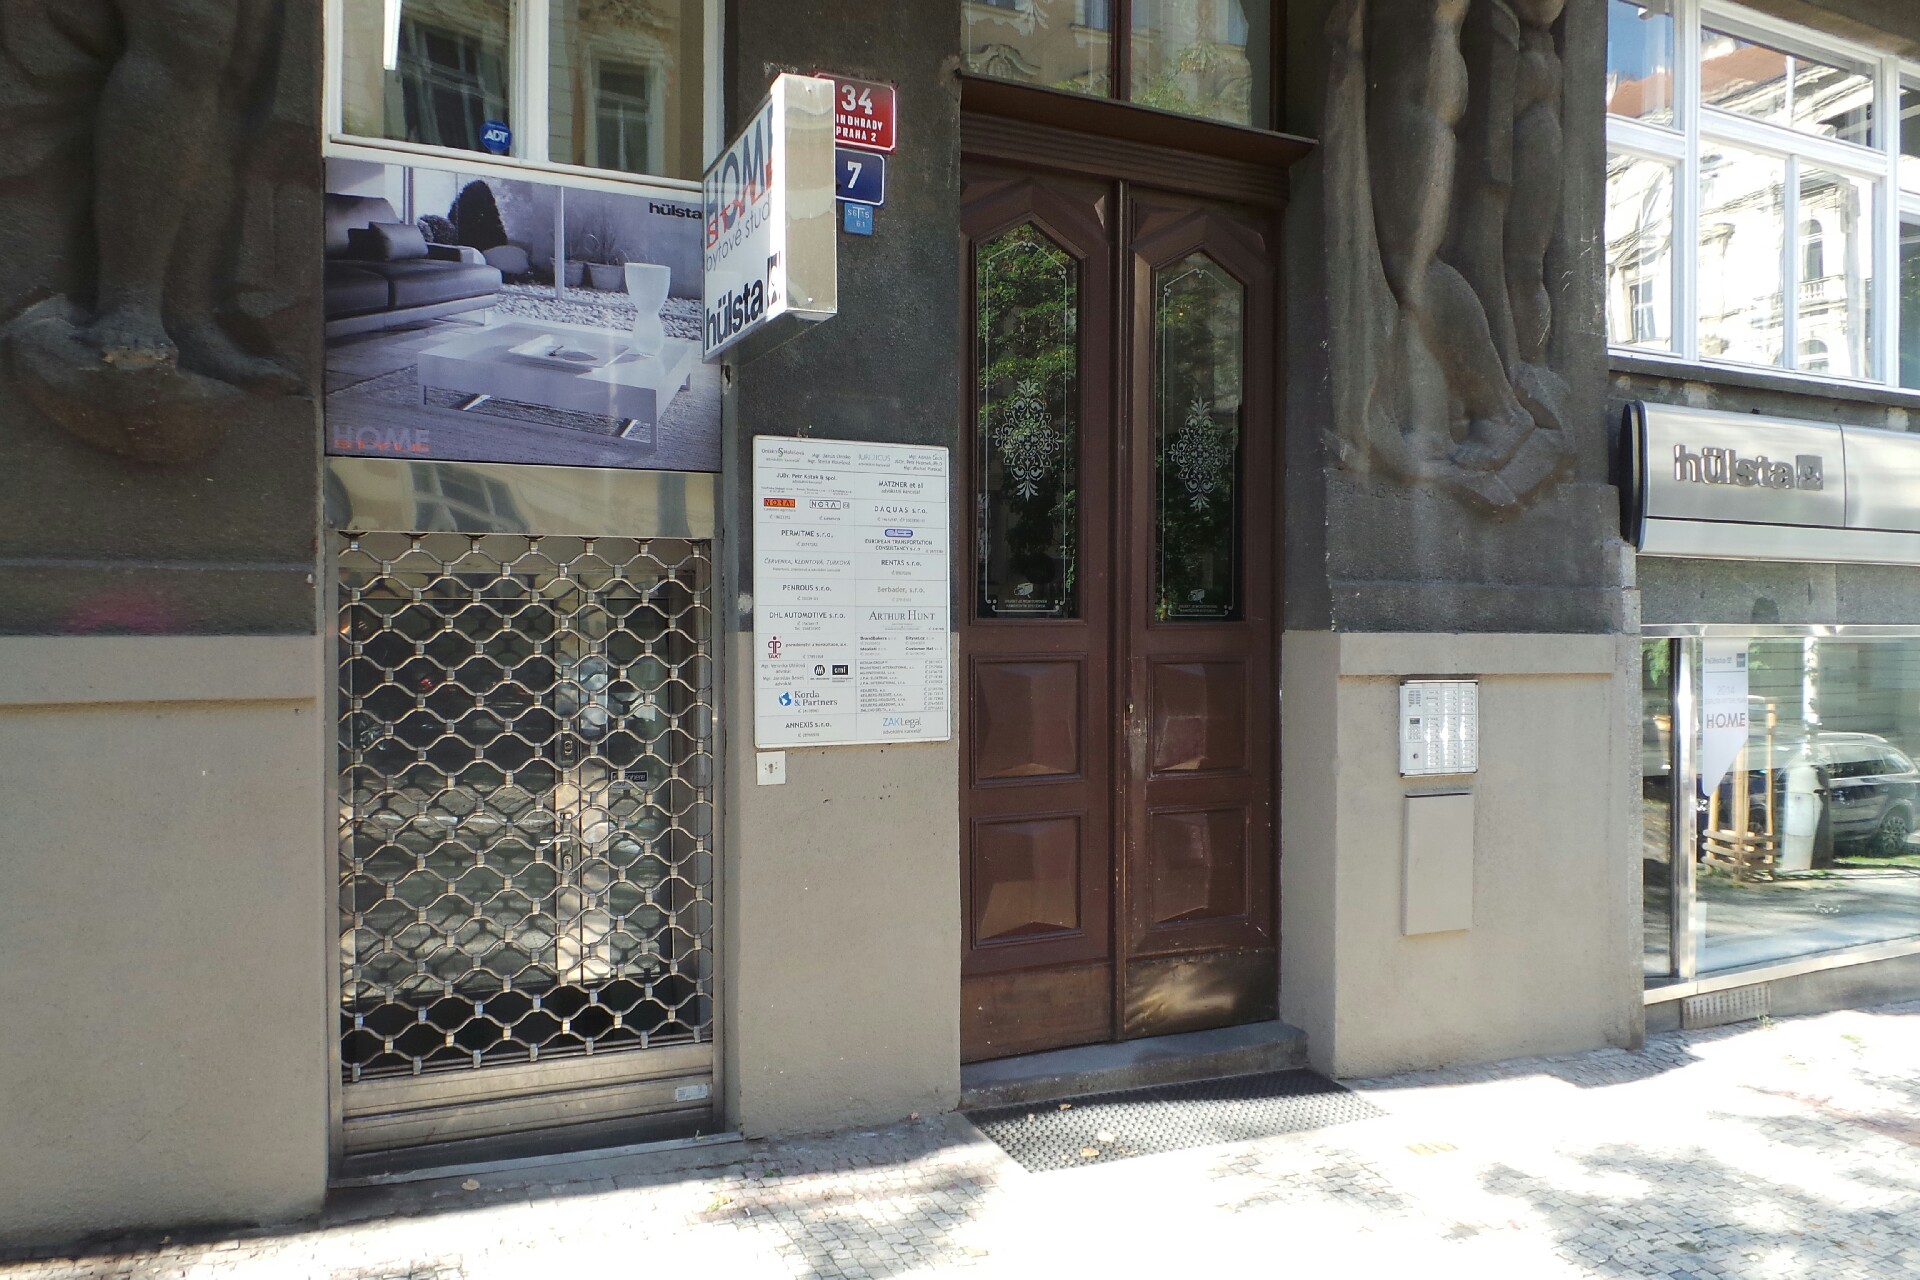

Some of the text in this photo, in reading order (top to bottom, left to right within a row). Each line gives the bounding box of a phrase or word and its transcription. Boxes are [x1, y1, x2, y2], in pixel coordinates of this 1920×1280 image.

[841, 84, 873, 115] 34
[836, 114, 884, 130] INOHRADY
[484, 130, 508, 143] ADT
[836, 128, 877, 142] PRAHA 2
[847, 161, 862, 189] 7
[649, 202, 703, 220] hülsta
[706, 221, 742, 272] bytové
[706, 279, 763, 350] hülsta
[1674, 444, 1796, 489] hülsta
[875, 506, 909, 514] DAQUAS
[794, 690, 819, 698] Korda
[1706, 713, 1746, 729] HOME
